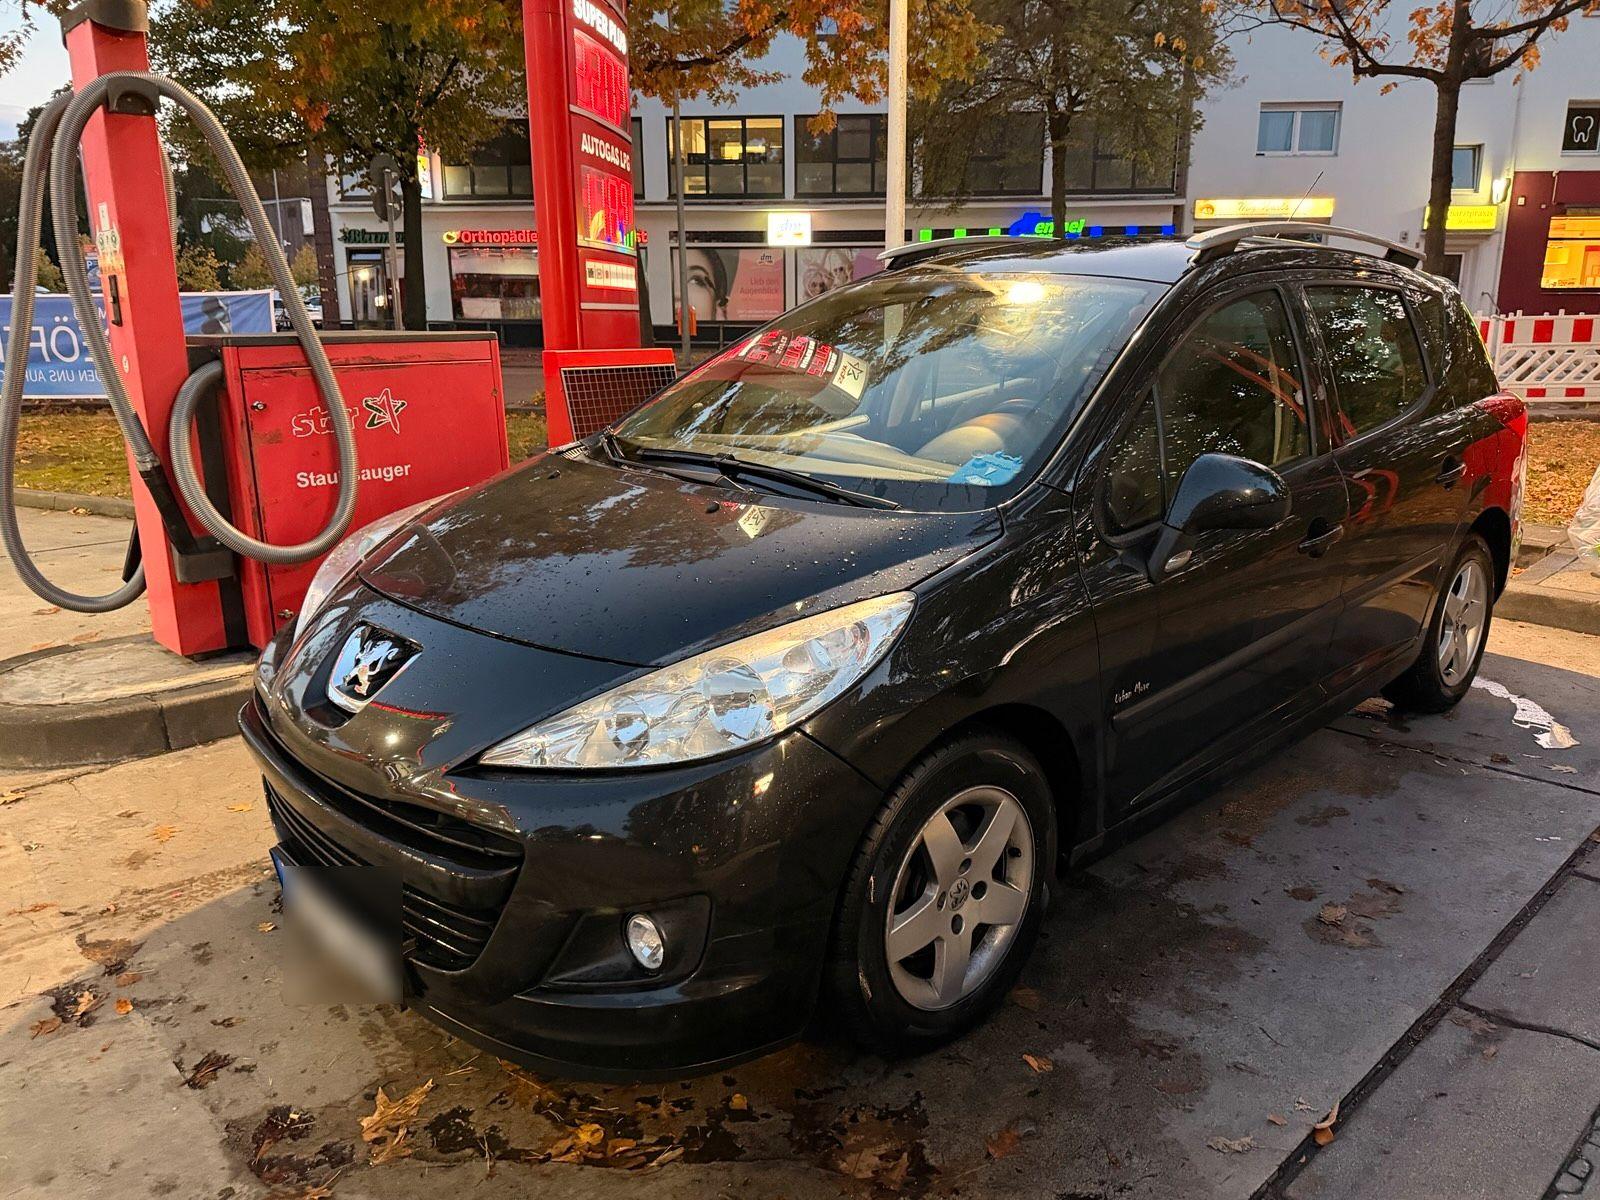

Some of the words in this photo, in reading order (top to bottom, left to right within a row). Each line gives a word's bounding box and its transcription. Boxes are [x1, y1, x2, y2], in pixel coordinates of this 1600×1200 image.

[580, 132, 620, 167] AUTOGAS
[619, 151, 631, 172] LPG
[461, 230, 539, 245] Orthopädie
[760, 253, 772, 261] dm
[296, 464, 412, 488] Stauauger
